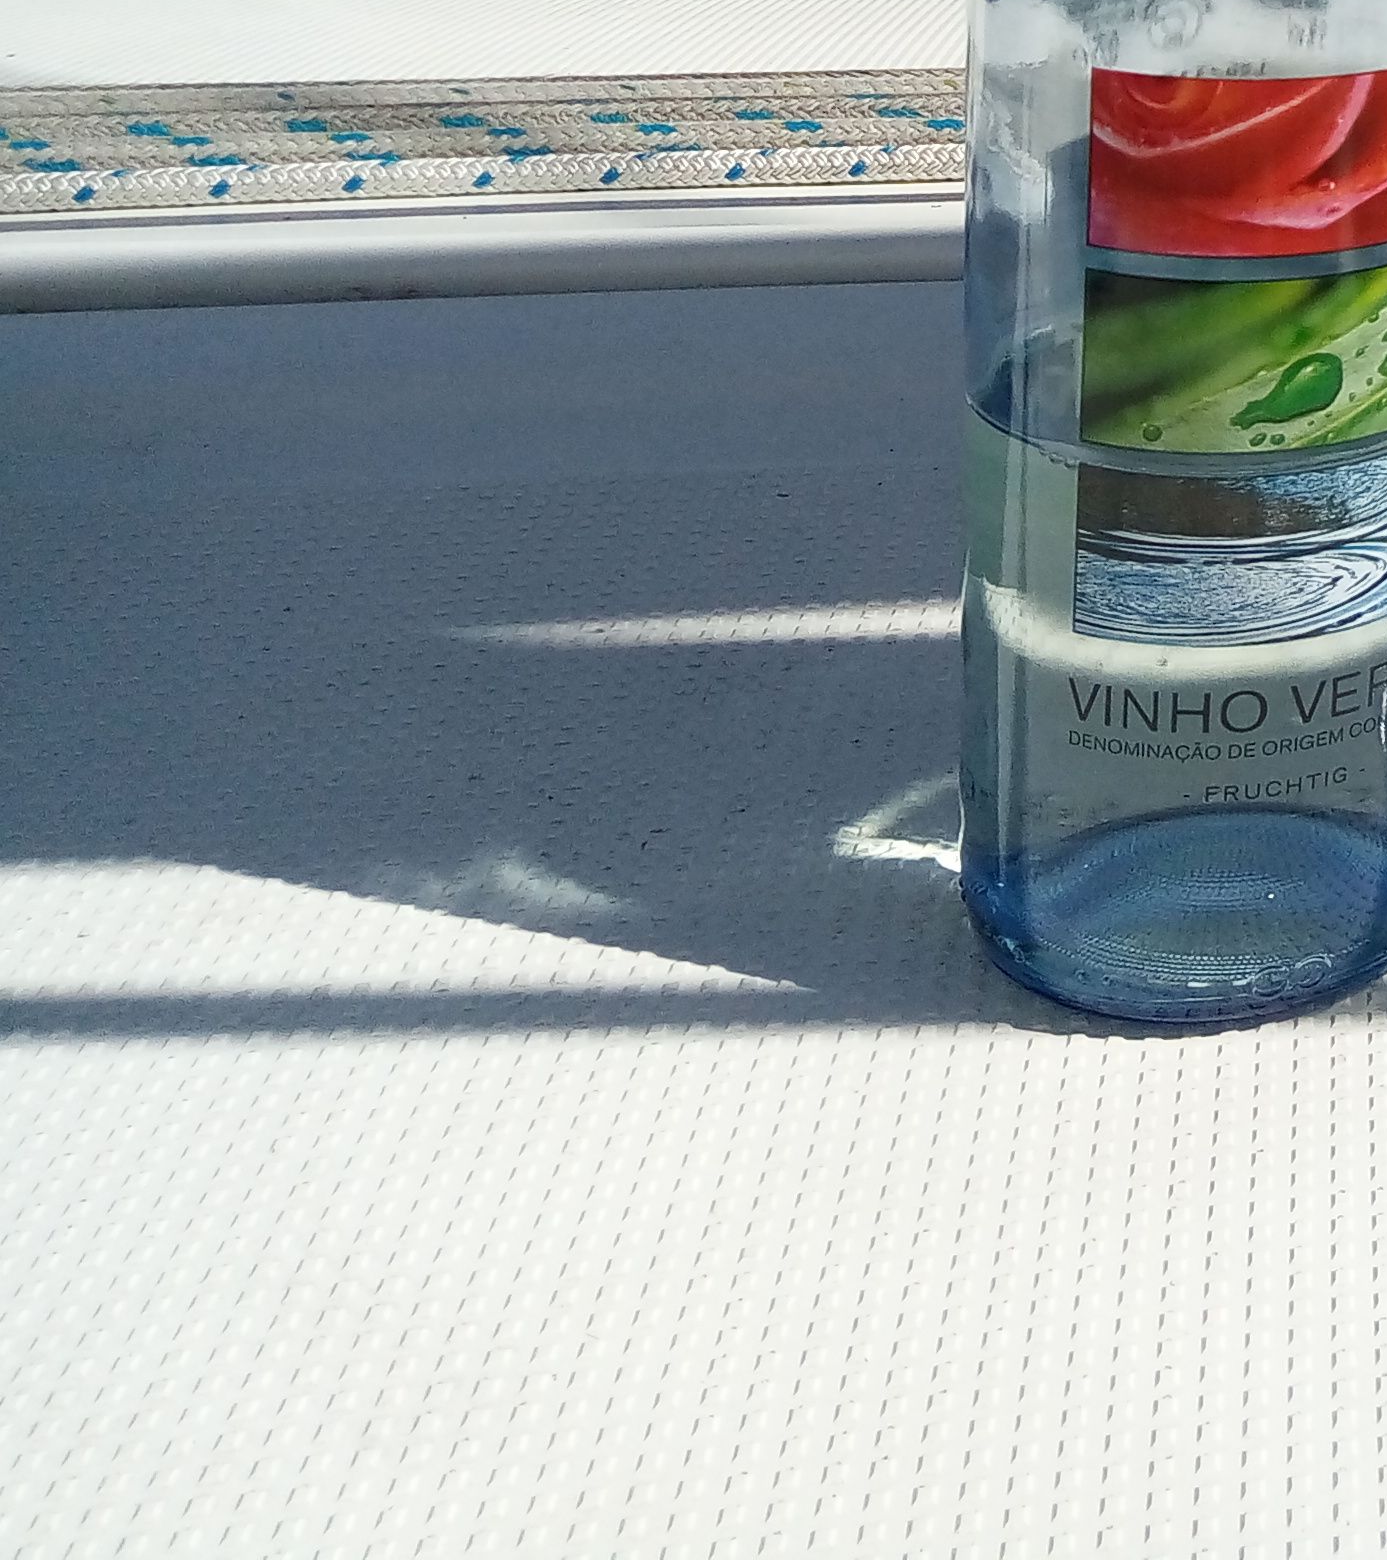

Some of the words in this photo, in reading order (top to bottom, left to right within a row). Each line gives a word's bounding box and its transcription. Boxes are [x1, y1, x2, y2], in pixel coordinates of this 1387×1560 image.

[1068, 676, 1268, 734] VINHO
[1068, 729, 1222, 763] DENOMINAÇÃO
[1227, 741, 1256, 760] DE
[1261, 727, 1344, 759] ORIGEM
[1203, 765, 1349, 803] FRUCHTIG
